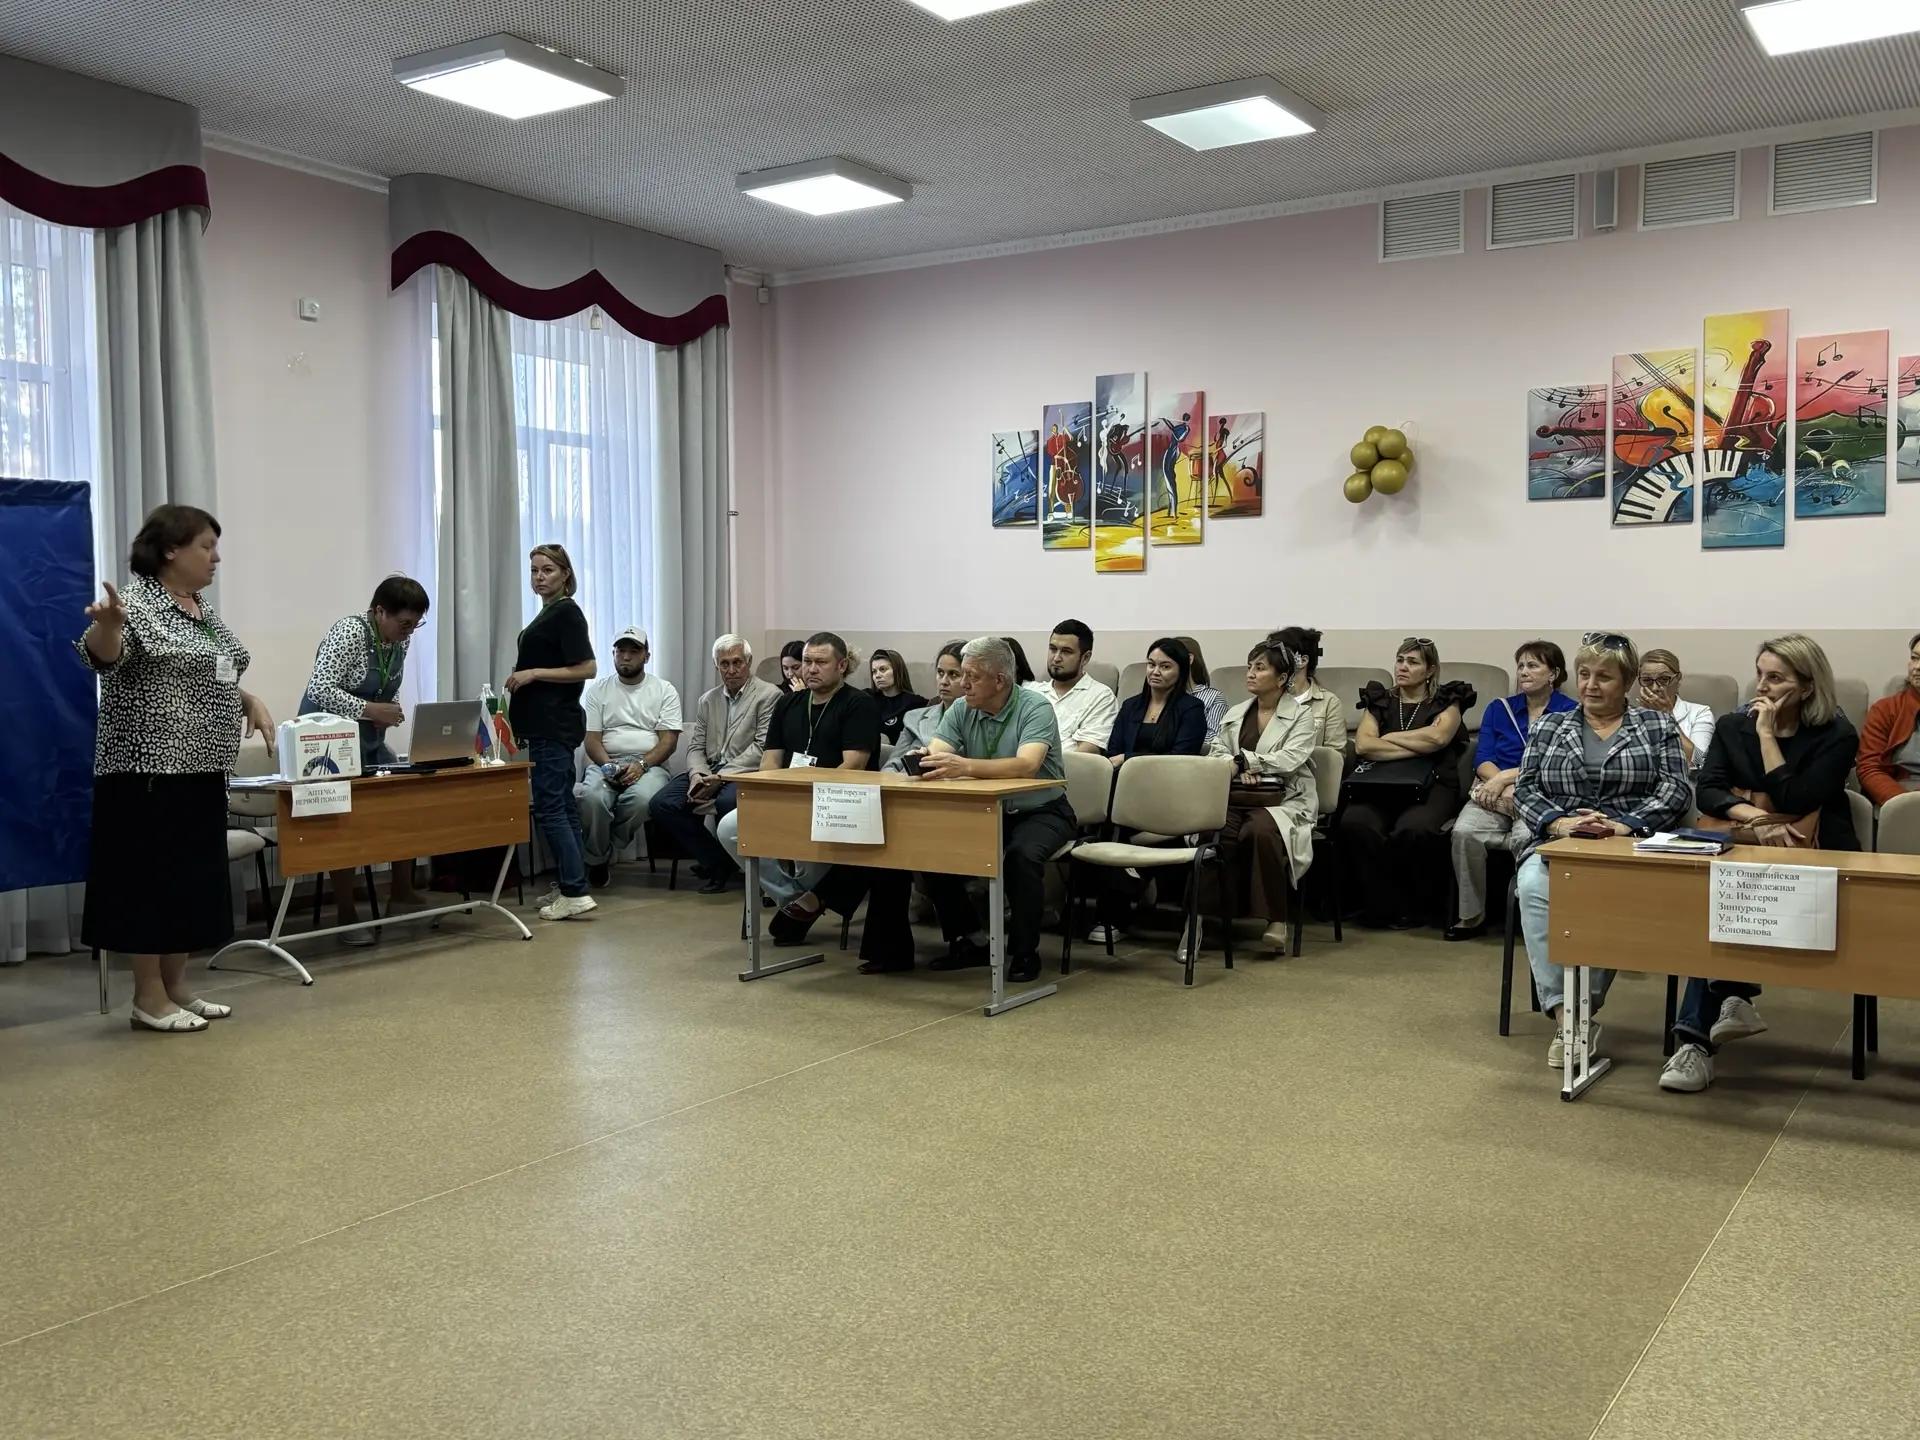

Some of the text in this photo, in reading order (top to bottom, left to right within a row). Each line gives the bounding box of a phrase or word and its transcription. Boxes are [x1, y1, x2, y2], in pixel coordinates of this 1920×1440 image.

[1719, 868, 1800, 881] Ул. Олимпийская
[1719, 880, 1796, 892] Ул. Молодежная
[1719, 891, 1734, 900] Ул.
[1718, 902, 1767, 914] Зиннурова
[1718, 913, 1733, 922] Ул.
[1718, 925, 1772, 937] Коновалова
